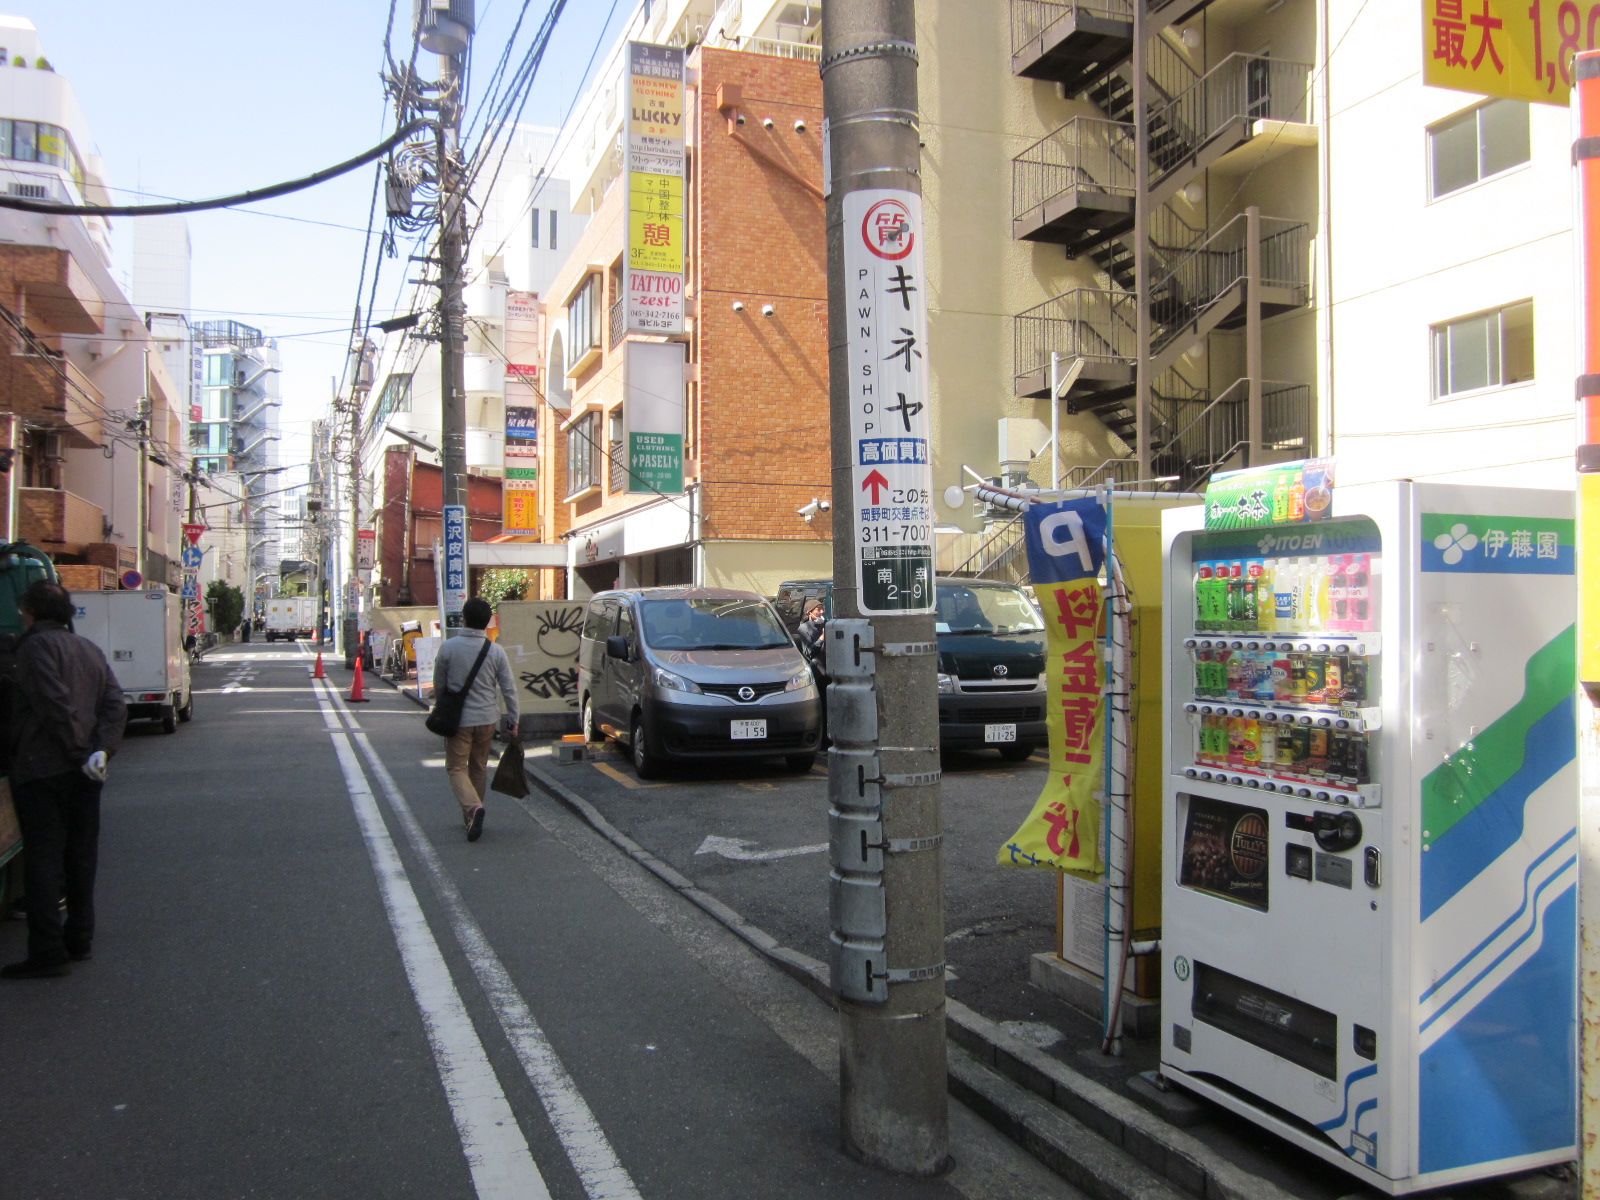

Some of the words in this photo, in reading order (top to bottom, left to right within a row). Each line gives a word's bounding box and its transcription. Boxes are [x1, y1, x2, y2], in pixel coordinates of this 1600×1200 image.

[1432, 0, 1504, 75] 最大
[631, 108, 682, 126] LUCKY
[659, 178, 670, 222] 中国整体
[643, 223, 671, 247] 憩
[631, 247, 646, 259] 3F
[630, 273, 681, 295] TATTOO
[882, 264, 924, 433] キネヤ
[636, 435, 665, 445] USED
[636, 444, 676, 452] CLOTHING
[861, 440, 927, 463] 高価買取
[638, 454, 672, 468] PASELI
[892, 488, 929, 505] この先
[861, 507, 930, 522] 岡野町交差点そば
[861, 524, 931, 543] 311-7007
[1275, 536, 1300, 551] ITO
[1301, 533, 1323, 549] EN
[1481, 528, 1559, 560] 伊藤園
